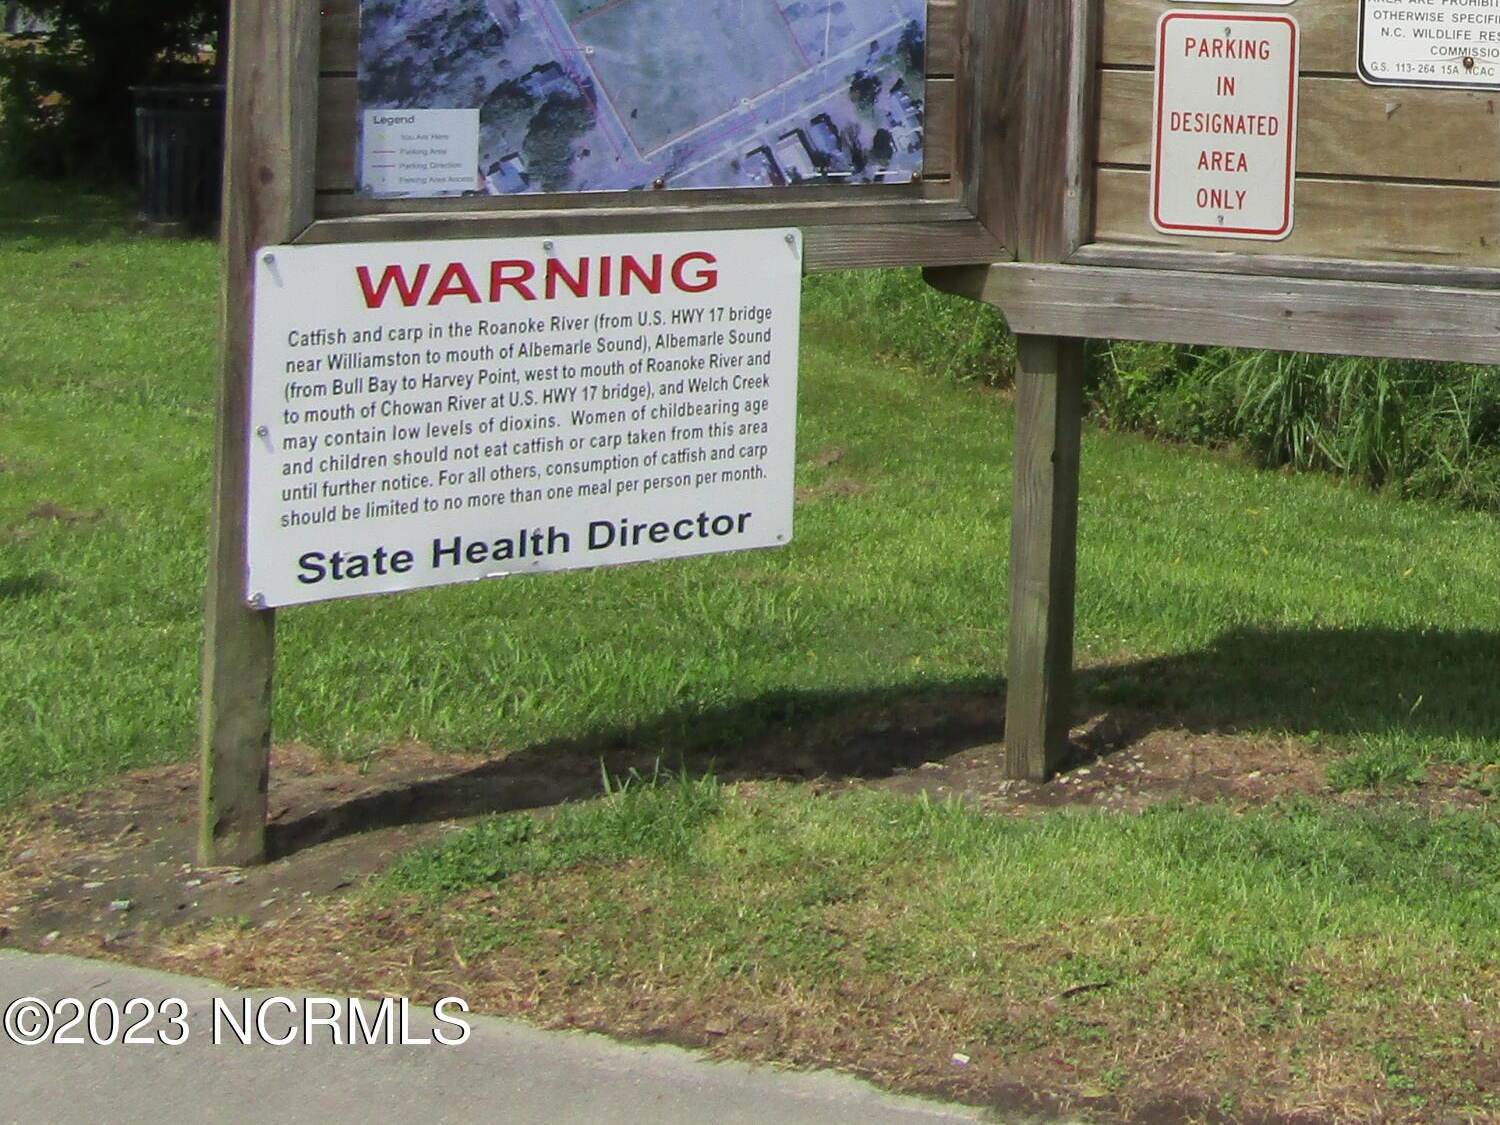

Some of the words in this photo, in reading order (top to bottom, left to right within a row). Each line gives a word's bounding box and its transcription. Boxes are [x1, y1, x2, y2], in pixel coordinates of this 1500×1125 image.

[1185, 38, 1270, 60] PARKING
[1217, 76, 1235, 96] IN
[374, 116, 415, 126] Legend
[1171, 112, 1278, 135] DESIGNATED
[1198, 151, 1248, 172] AREA
[1197, 188, 1246, 210] ONLY
[356, 251, 718, 308] WARNING
[288, 328, 346, 347] Catfish
[353, 326, 382, 343] and
[389, 327, 423, 346] carp
[429, 323, 442, 337] in
[449, 322, 472, 336] the
[478, 317, 544, 336] Roanoke
[551, 315, 589, 331] River
[594, 313, 632, 332] (from
[638, 310, 666, 326] U.S.
[671, 309, 704, 324] HWY
[709, 308, 724, 322] 17
[729, 306, 772, 324] bridge
[286, 359, 321, 373] near
[328, 352, 420, 370] Williamston
[426, 350, 441, 363] to
[446, 345, 494, 362] mouth
[500, 343, 514, 358] of
[518, 339, 591, 357] Albemarle
[597, 335, 650, 353] Sound),
[655, 332, 724, 349] Albemarle
[729, 328, 771, 343] Sound
[298, 546, 414, 584] State
[432, 526, 570, 568] Health
[588, 512, 752, 550] Director
